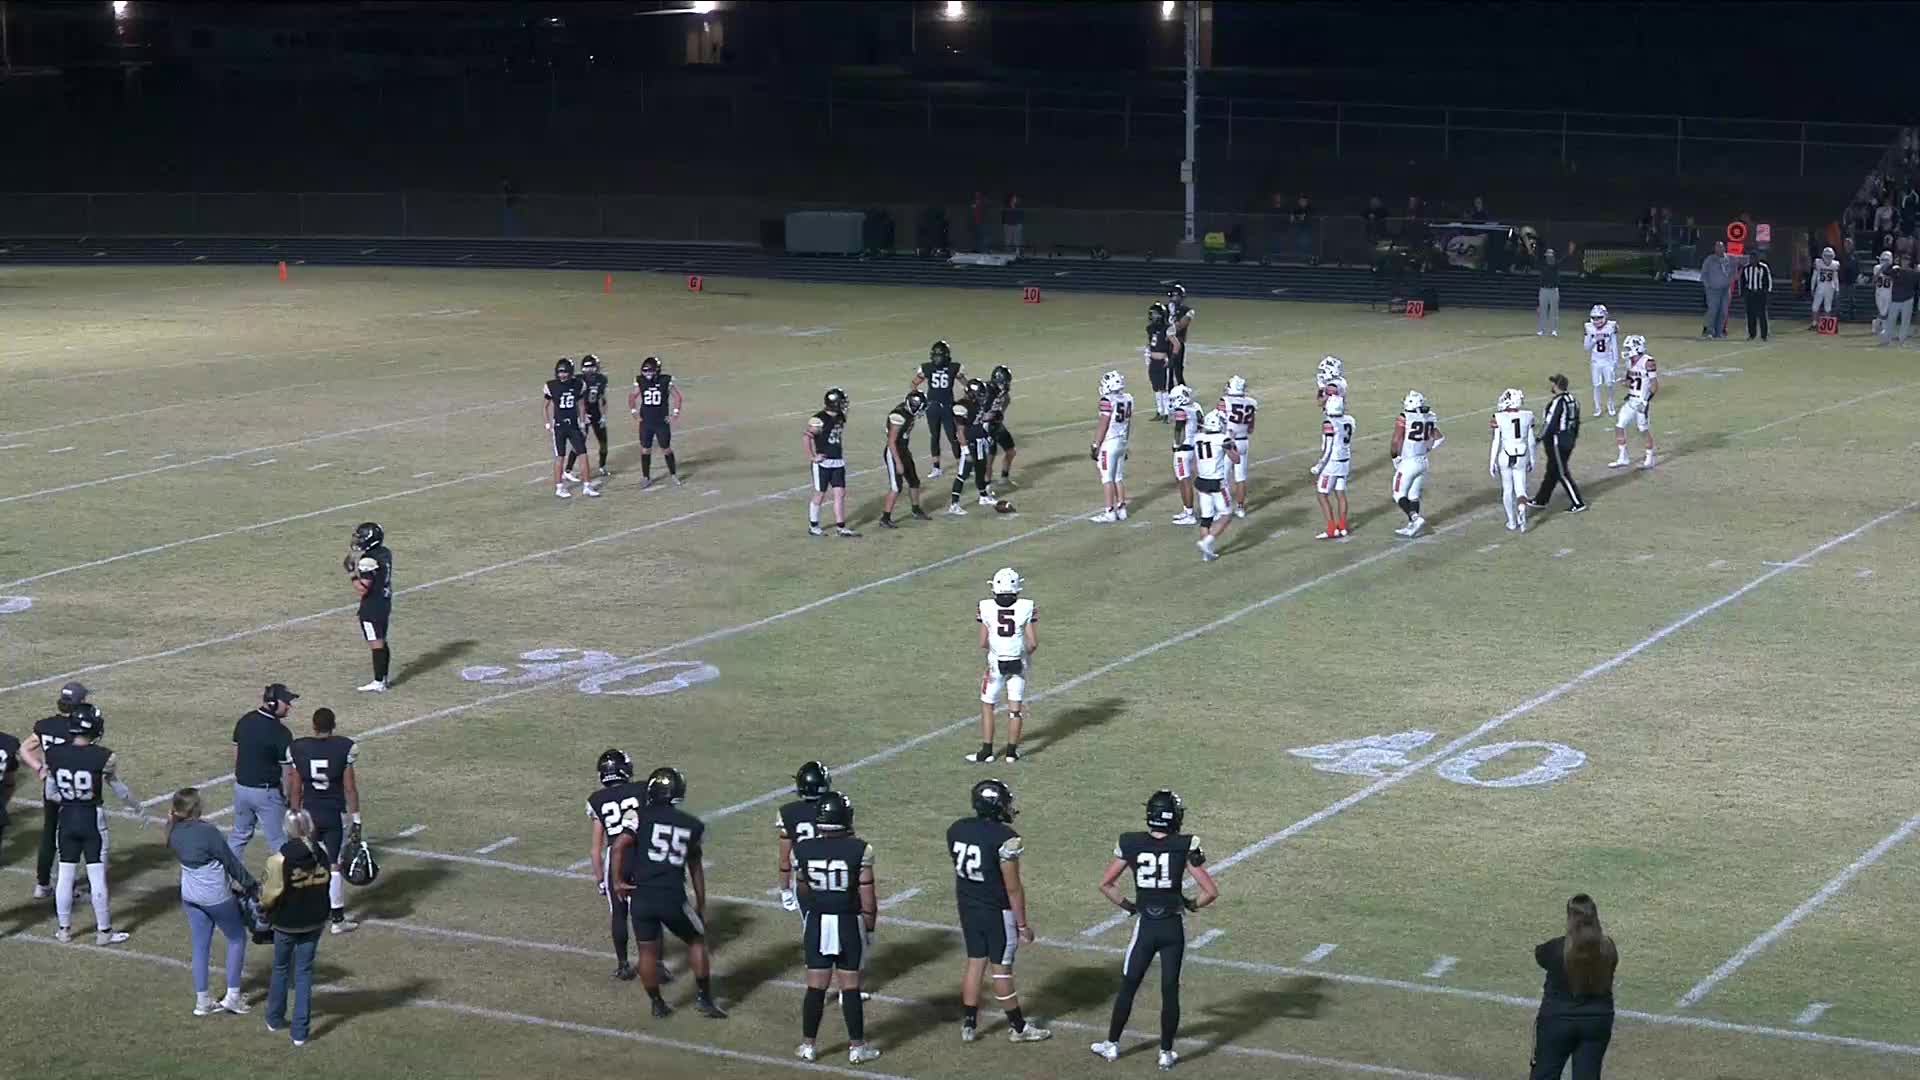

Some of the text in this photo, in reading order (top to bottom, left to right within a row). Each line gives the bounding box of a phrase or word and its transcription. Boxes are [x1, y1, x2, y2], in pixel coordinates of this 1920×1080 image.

[1024, 288, 1037, 301] 10
[1407, 302, 1422, 315] 20
[1819, 317, 1834, 333] 30
[1596, 339, 1606, 353] 8
[931, 373, 949, 389] 56
[643, 390, 661, 406] 20
[1229, 403, 1255, 425] 52
[1343, 423, 1353, 445] 3
[1511, 417, 1522, 439] 1
[1195, 440, 1213, 460] 11
[997, 609, 1016, 638] 5
[1287, 729, 1586, 788] 40
[310, 759, 330, 791] 5
[647, 823, 691, 866] 55
[953, 841, 985, 882] 72
[1136, 852, 1173, 889] 21
[807, 859, 849, 892] 50
